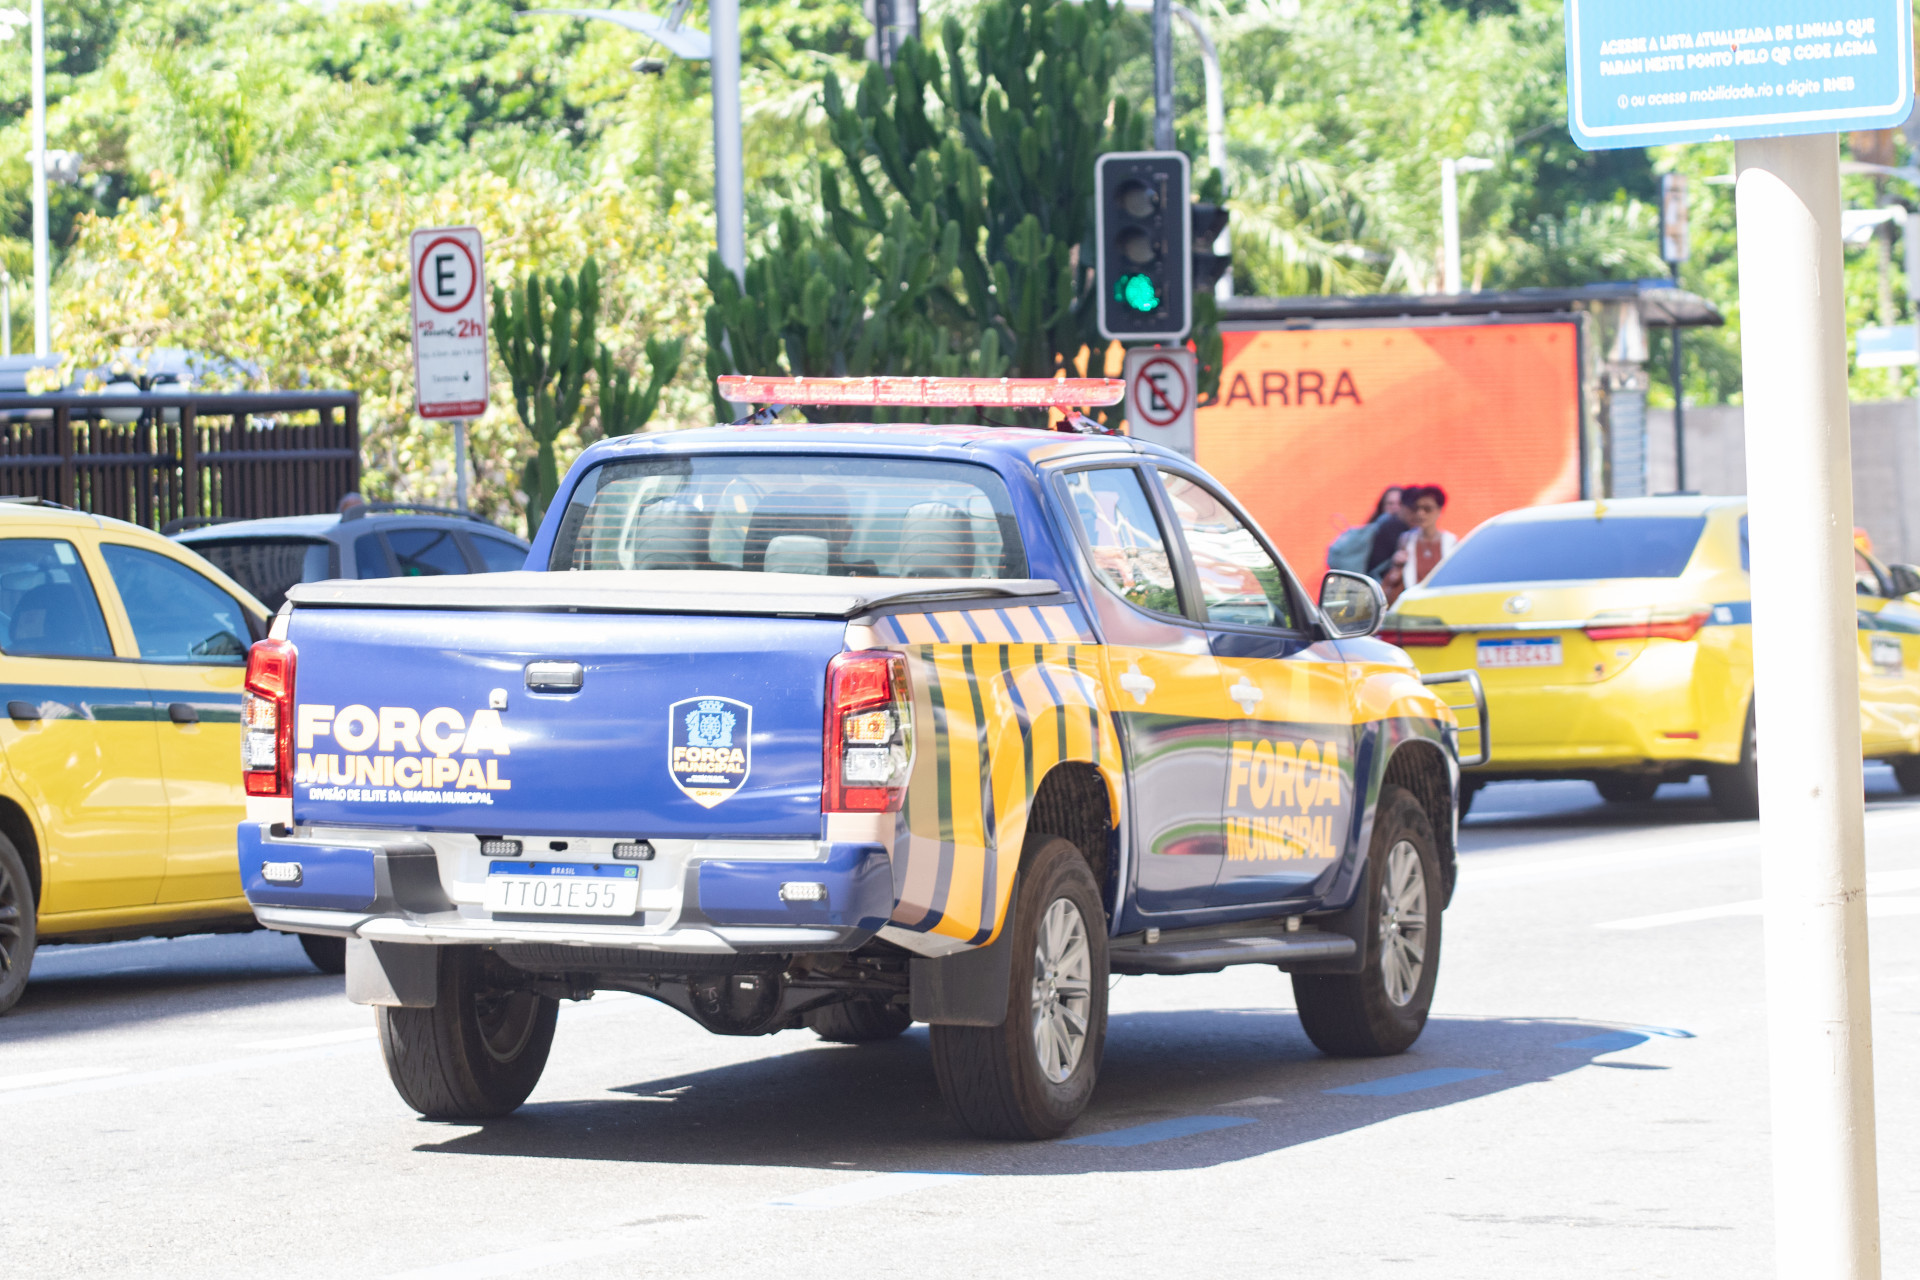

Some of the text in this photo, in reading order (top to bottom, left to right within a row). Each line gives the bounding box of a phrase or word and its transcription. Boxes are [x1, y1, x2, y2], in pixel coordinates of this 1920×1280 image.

[1600, 17, 1875, 56] ACESSE A LISTA ATUALIZADA DE LINHAS QUE
[1600, 39, 1877, 76] PARAM NESTE PONTO PELO QR CODE ACIMA
[1631, 95, 1645, 107] ou
[1648, 92, 1687, 106] acesse
[1690, 82, 1773, 103] mobilidade.rio
[1775, 84, 1784, 96] e
[1786, 78, 1821, 98] digite
[435, 254, 456, 297] E
[457, 317, 482, 339] 2h
[1206, 371, 1362, 406] ARRA
[297, 704, 511, 758] FORÇA
[296, 753, 511, 790] MUNICIPAL
[673, 761, 745, 773] MUNICIPAL
[1228, 738, 1341, 815] FORÇA
[309, 787, 494, 805] DIVISÃO DE ELITE DA GUARDA MUNICIPAL
[1227, 815, 1337, 862] MUNICIPAL
[551, 867, 576, 875] BRASIL
